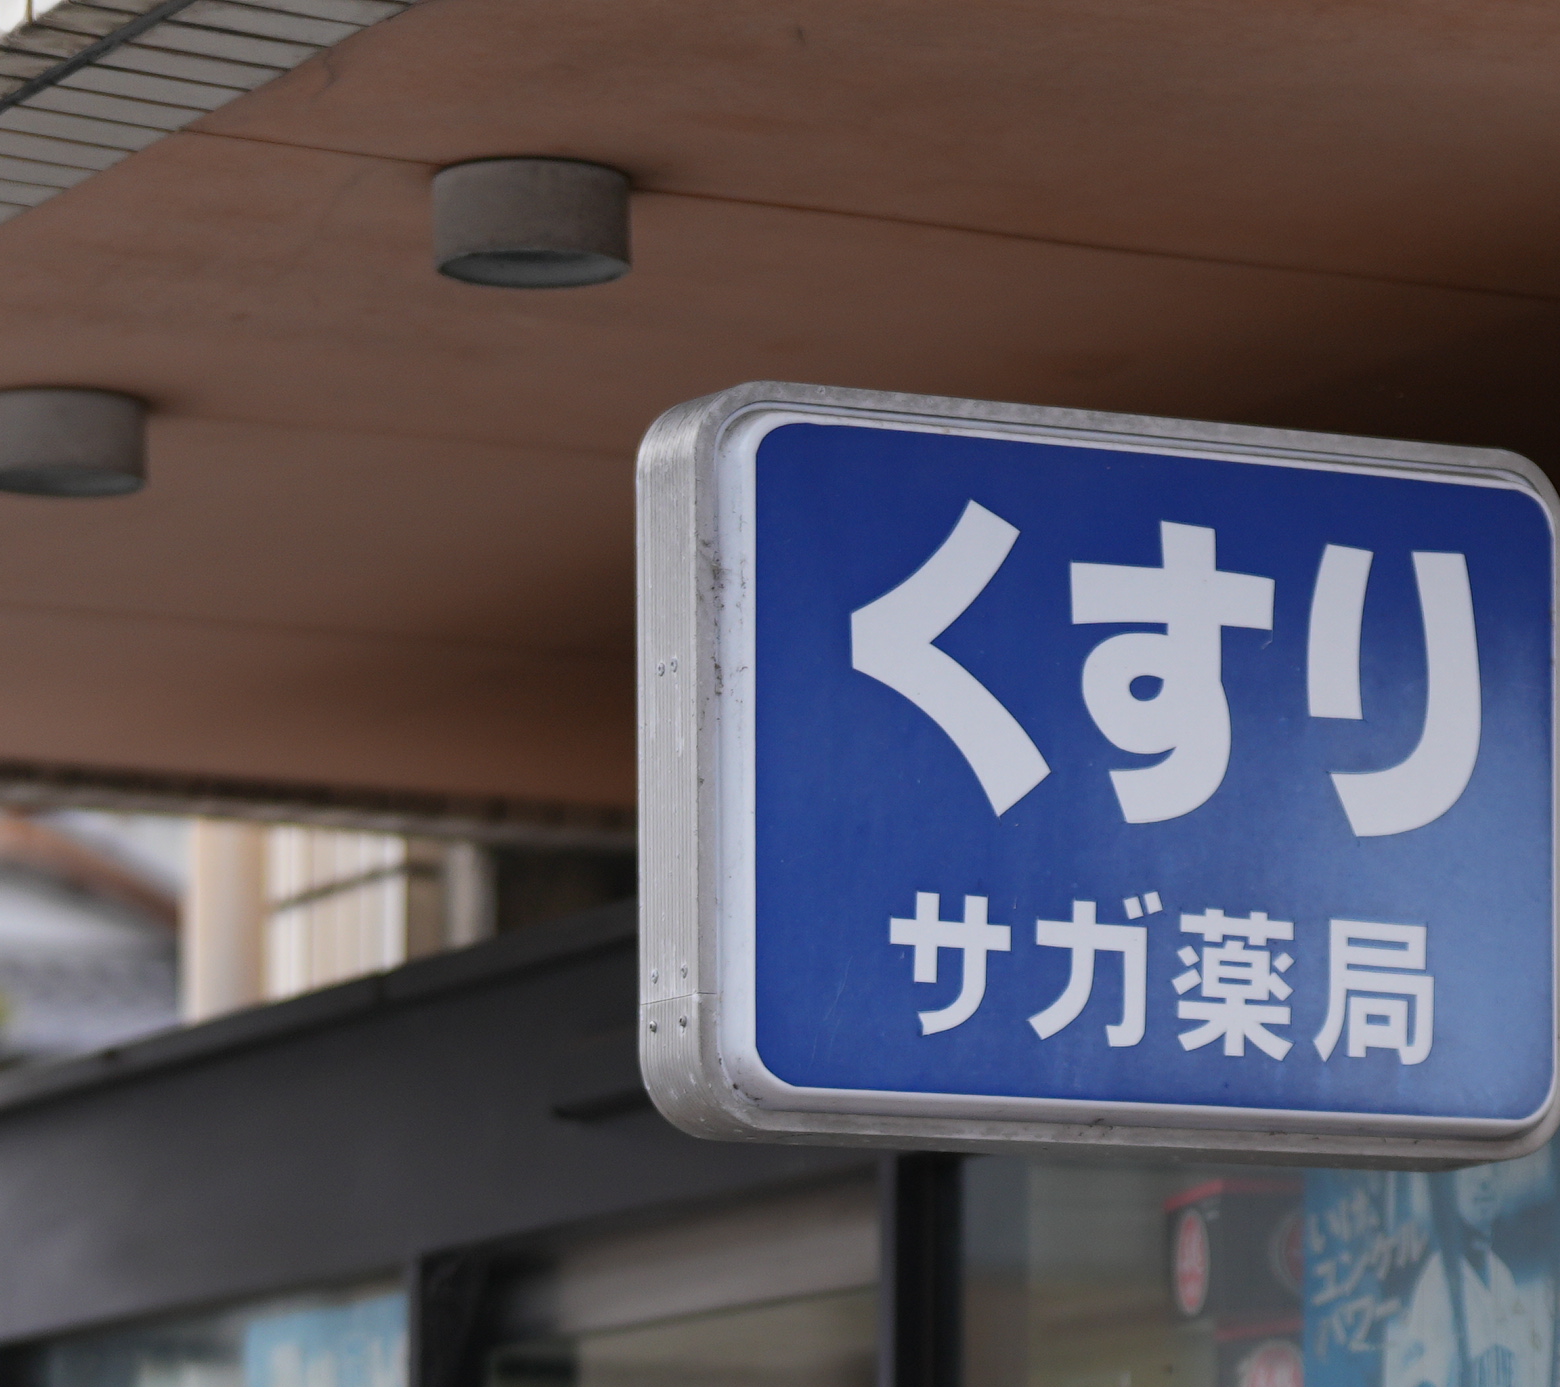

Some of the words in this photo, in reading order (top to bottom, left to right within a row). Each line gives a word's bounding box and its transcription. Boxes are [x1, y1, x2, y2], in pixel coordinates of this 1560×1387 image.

[850, 499, 1482, 838] くすり
[889, 890, 1435, 1066] サガ薬局
[1313, 1220, 1430, 1305] ユンケル
[1316, 1298, 1404, 1363] パワー
